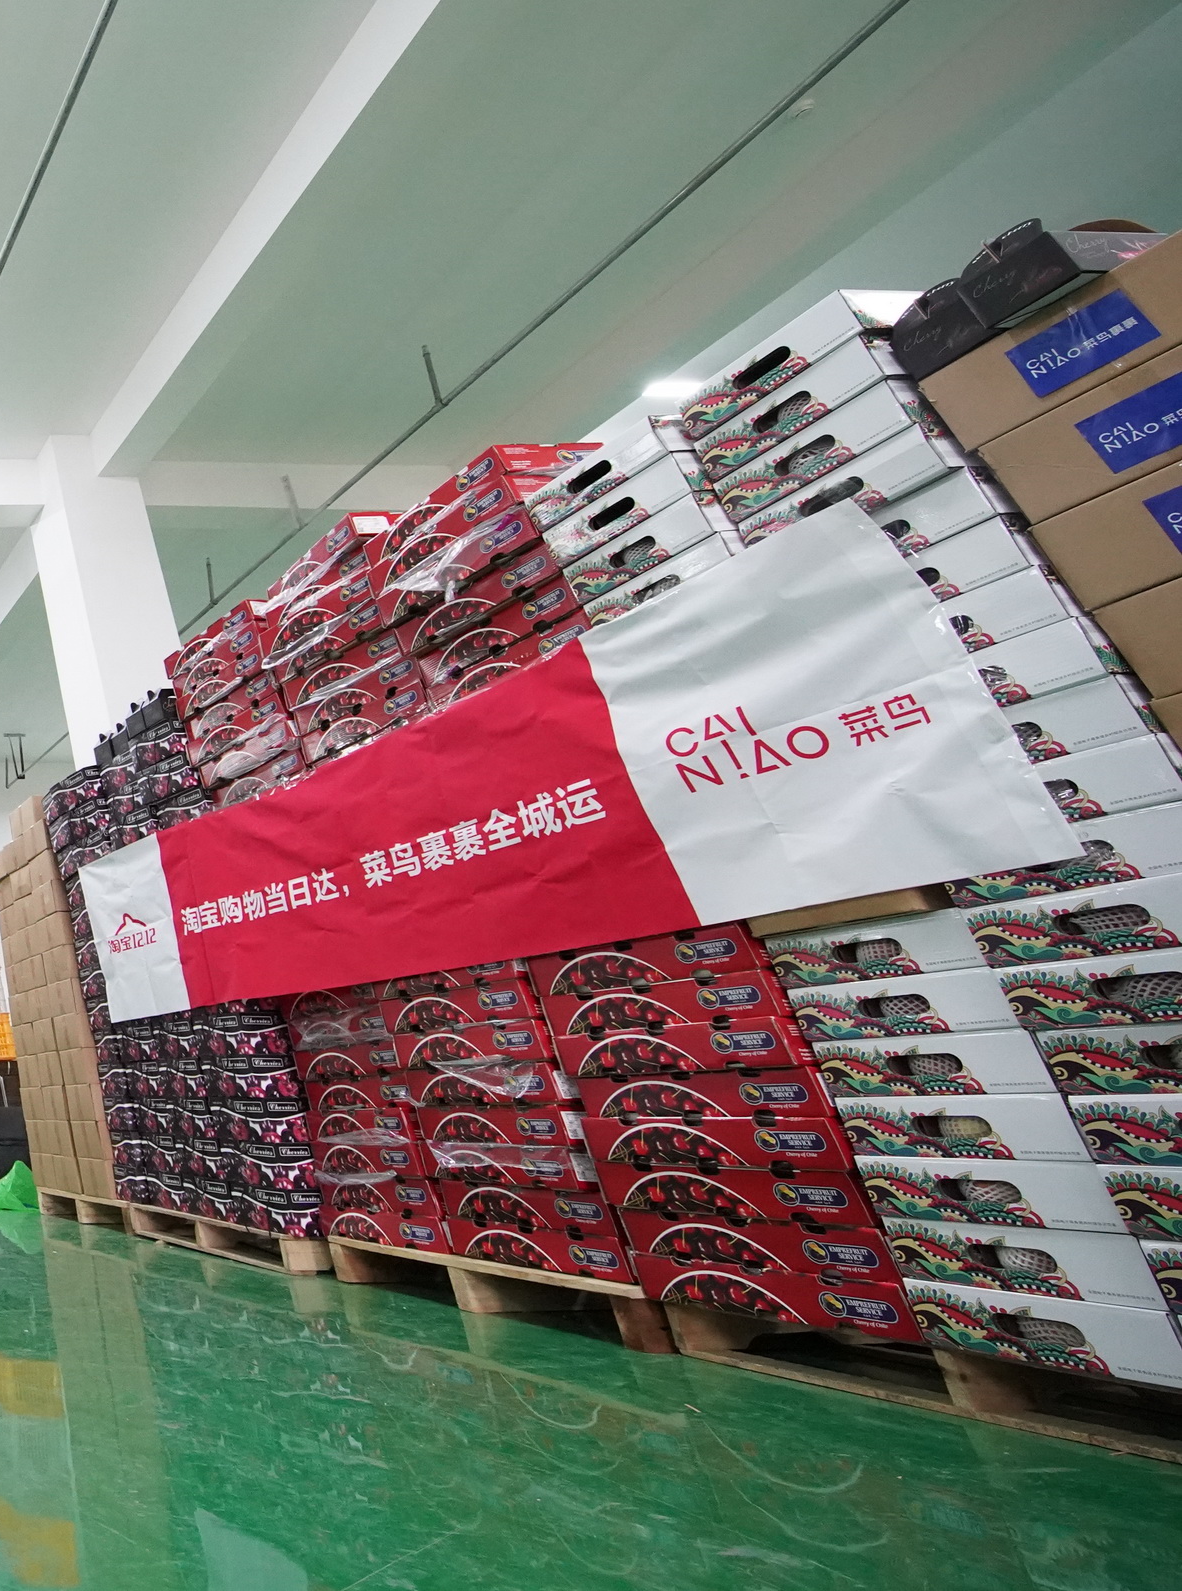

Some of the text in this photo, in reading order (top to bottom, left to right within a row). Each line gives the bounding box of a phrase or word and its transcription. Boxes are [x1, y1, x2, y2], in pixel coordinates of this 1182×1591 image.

[1026, 348, 1059, 370] CAI
[1098, 422, 1134, 443] CAI
[838, 693, 932, 747] 菜鸟
[838, 1253, 864, 1261] SERVICE
[856, 1306, 883, 1316] SERVICE
